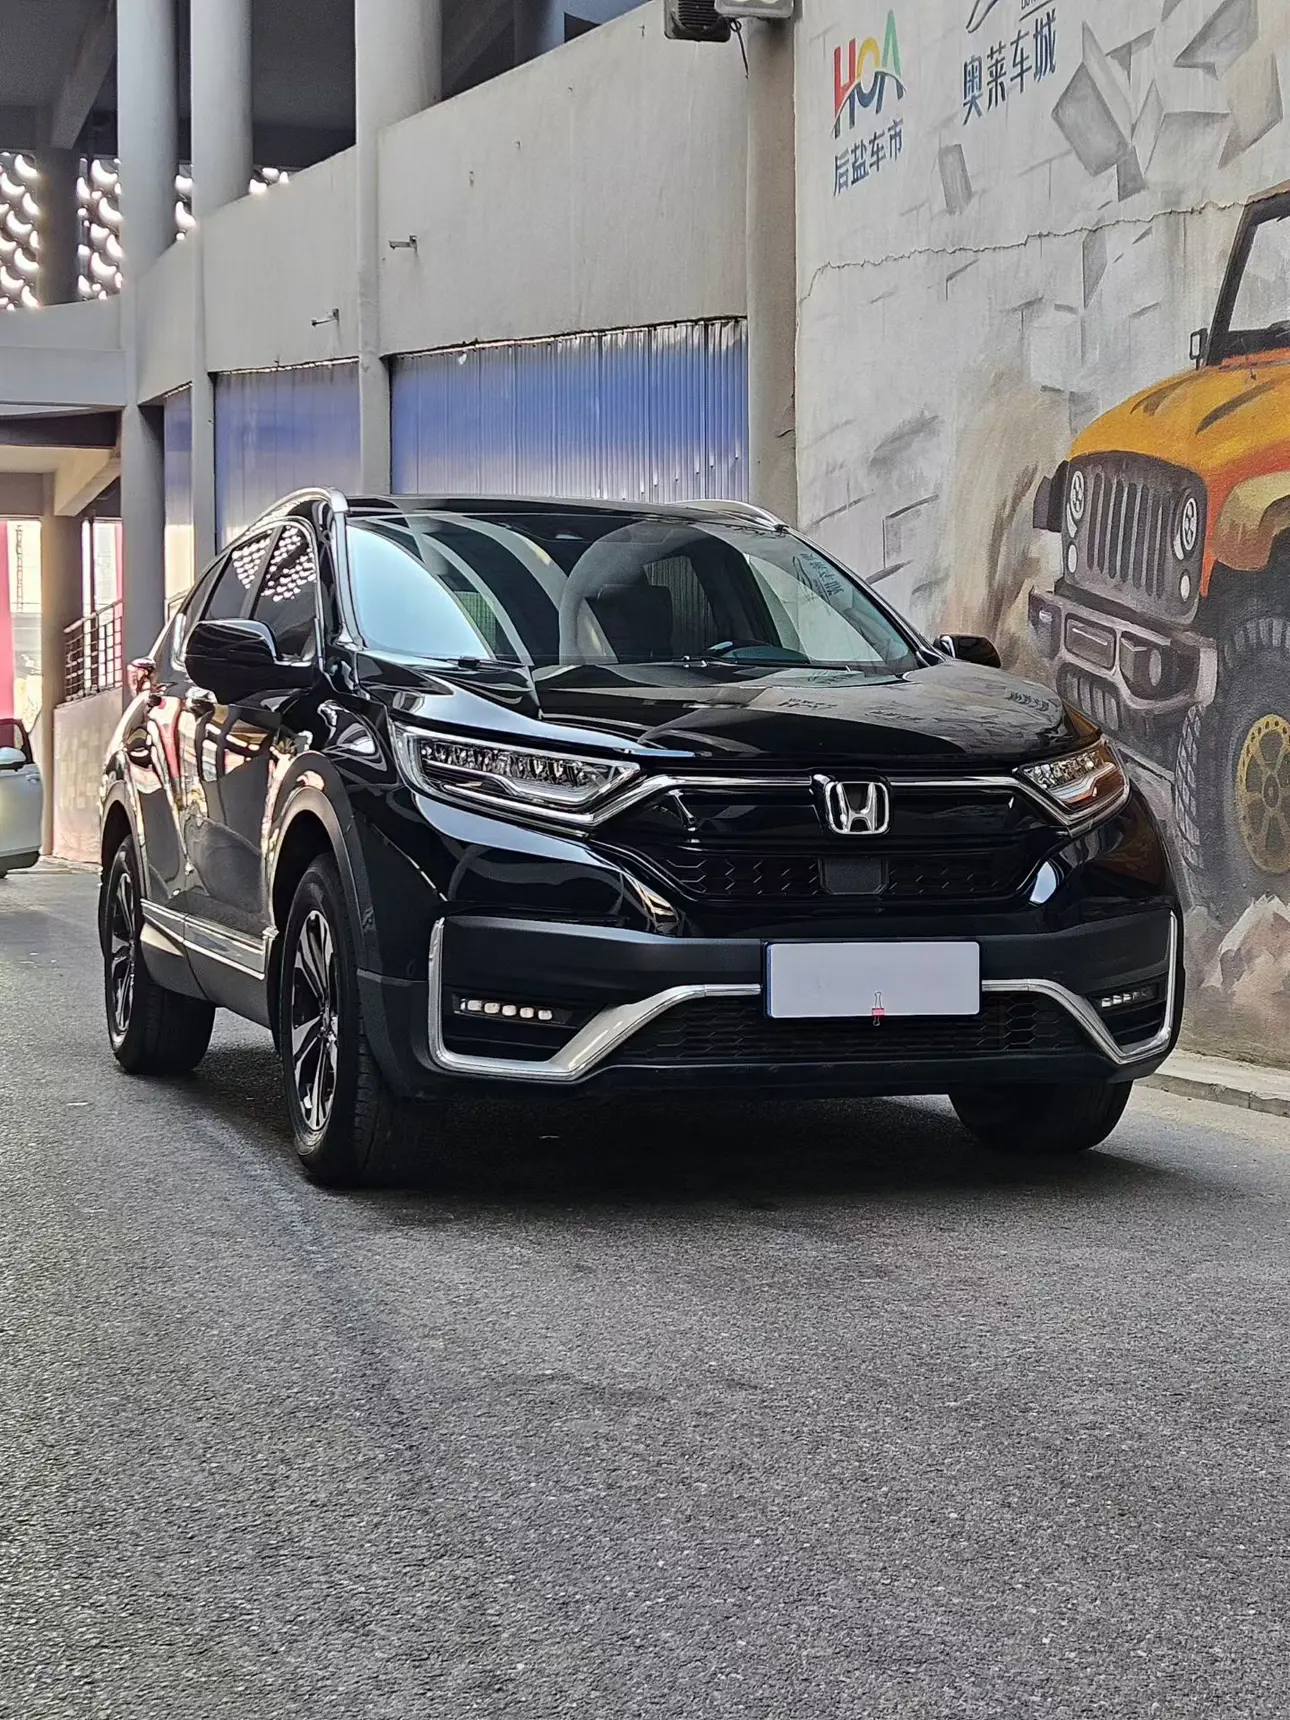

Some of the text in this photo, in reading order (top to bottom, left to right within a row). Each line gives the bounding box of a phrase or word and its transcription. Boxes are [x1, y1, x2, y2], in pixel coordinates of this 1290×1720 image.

[963, 8, 1056, 125] 奥莱车城
[834, 118, 903, 196] 后盐车市
